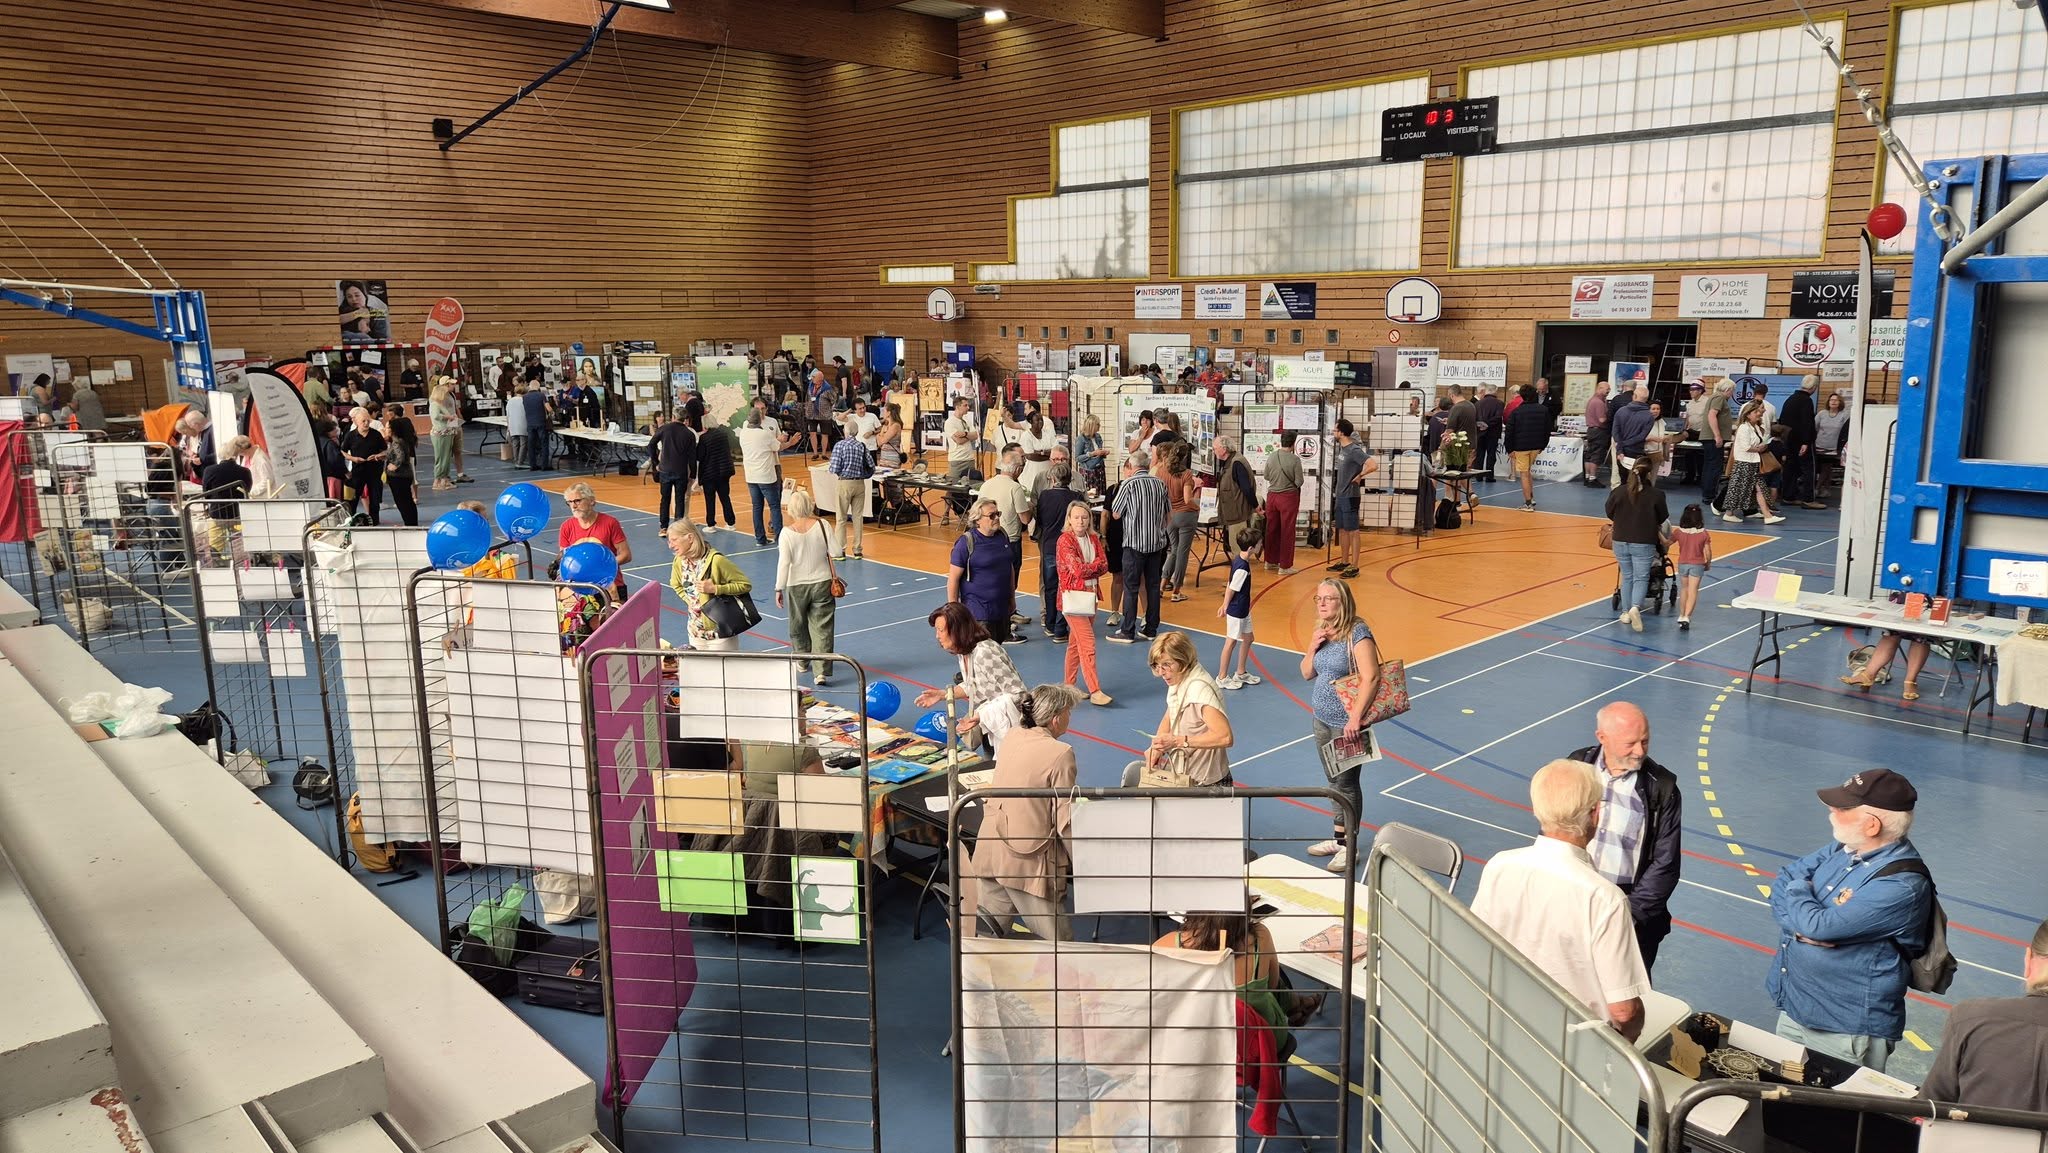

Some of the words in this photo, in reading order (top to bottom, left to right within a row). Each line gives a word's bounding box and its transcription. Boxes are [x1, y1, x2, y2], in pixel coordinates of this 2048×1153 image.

[1444, 109, 1454, 122] 3
[1447, 126, 1479, 135] VISITEURS
[1400, 131, 1426, 140] LOCAUX
[1809, 285, 1860, 298] NOVE
[1879, 325, 1900, 334] santé
[1793, 343, 1826, 352] STOP
[1871, 348, 1884, 357] des
[1887, 349, 1903, 357] solu
[1444, 366, 1459, 376] LYON
[1464, 367, 1470, 377] LA
[1472, 367, 1486, 377] PLAINE
[1496, 367, 1504, 377] FOY
[1560, 445, 1579, 461] Foy
